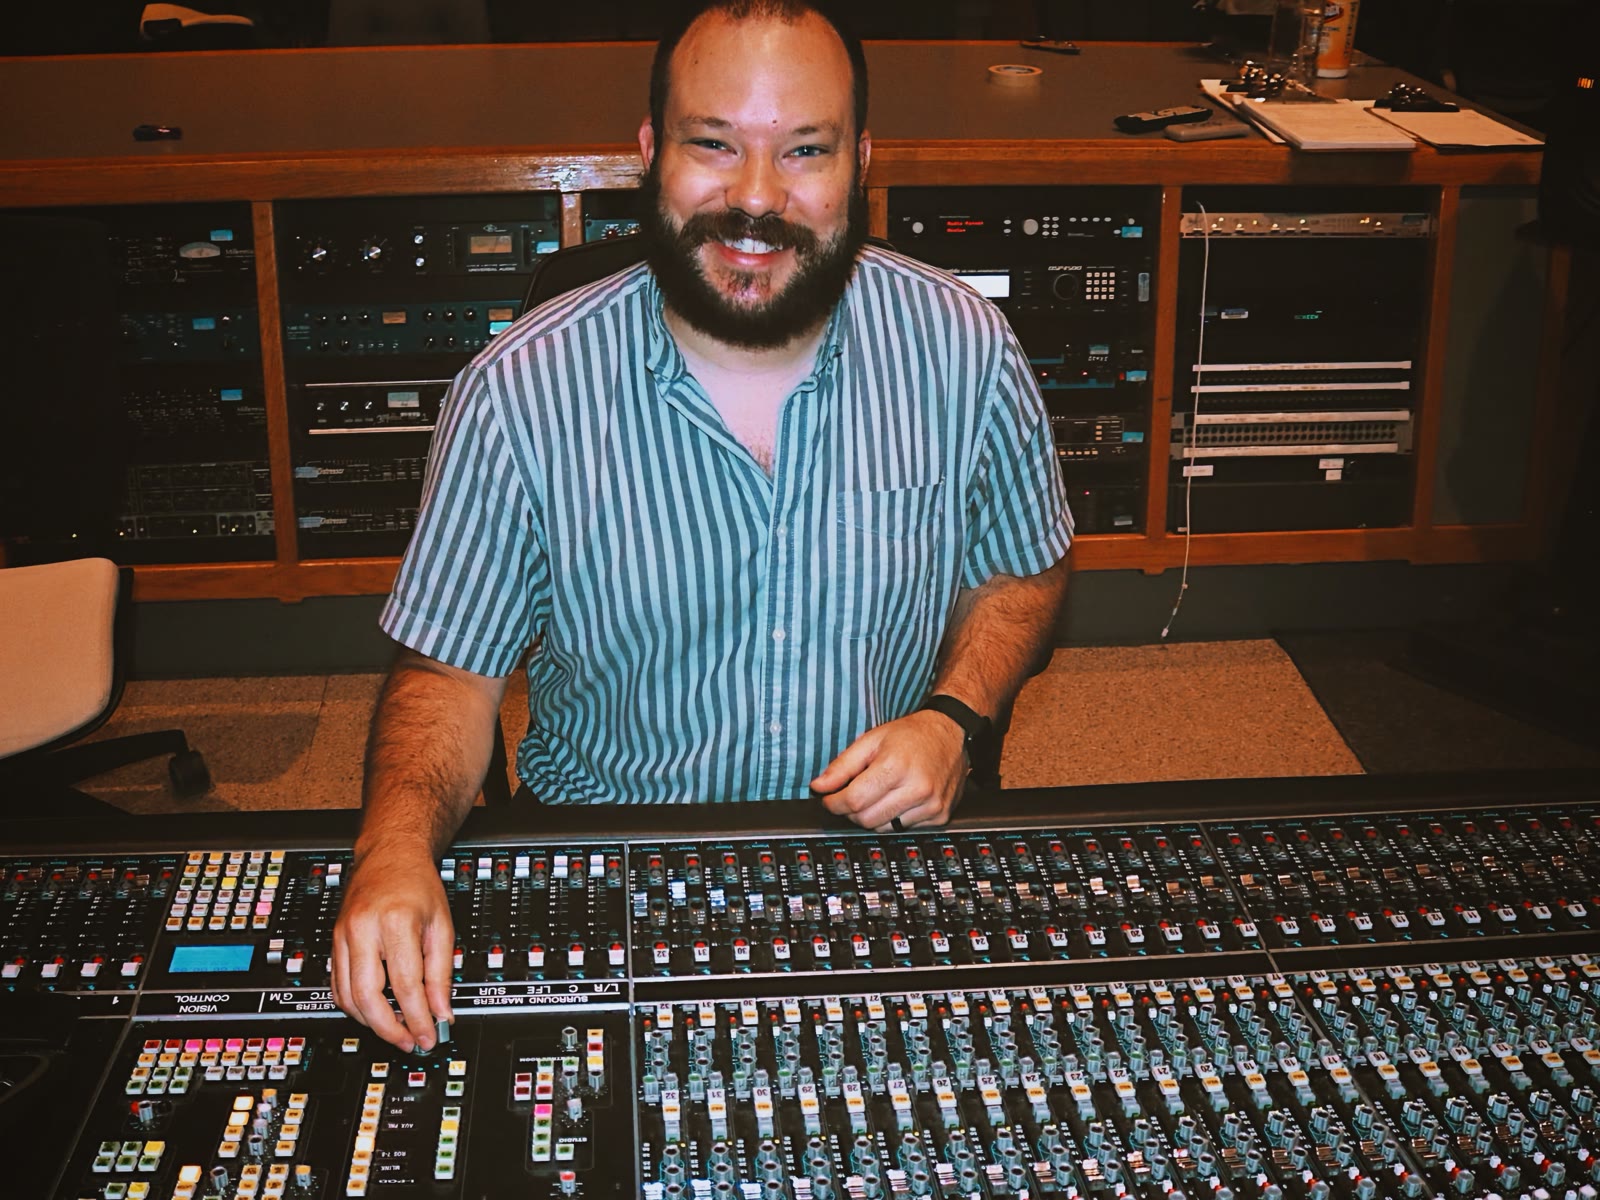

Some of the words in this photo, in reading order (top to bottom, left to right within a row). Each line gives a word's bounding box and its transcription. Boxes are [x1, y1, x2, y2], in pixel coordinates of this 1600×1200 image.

[478, 986, 506, 996] SUR
[526, 985, 551, 994] LFE
[568, 984, 578, 993] C
[593, 983, 619, 993] L/R
[173, 994, 230, 1004] CONTROL
[473, 997, 523, 1005] MASTERS
[528, 995, 588, 1004] SURROUND
[178, 1004, 217, 1013] VISION
[295, 1003, 336, 1011] ASTERS
[1374, 1053, 1385, 1061] 16
[1415, 1050, 1425, 1058] 15
